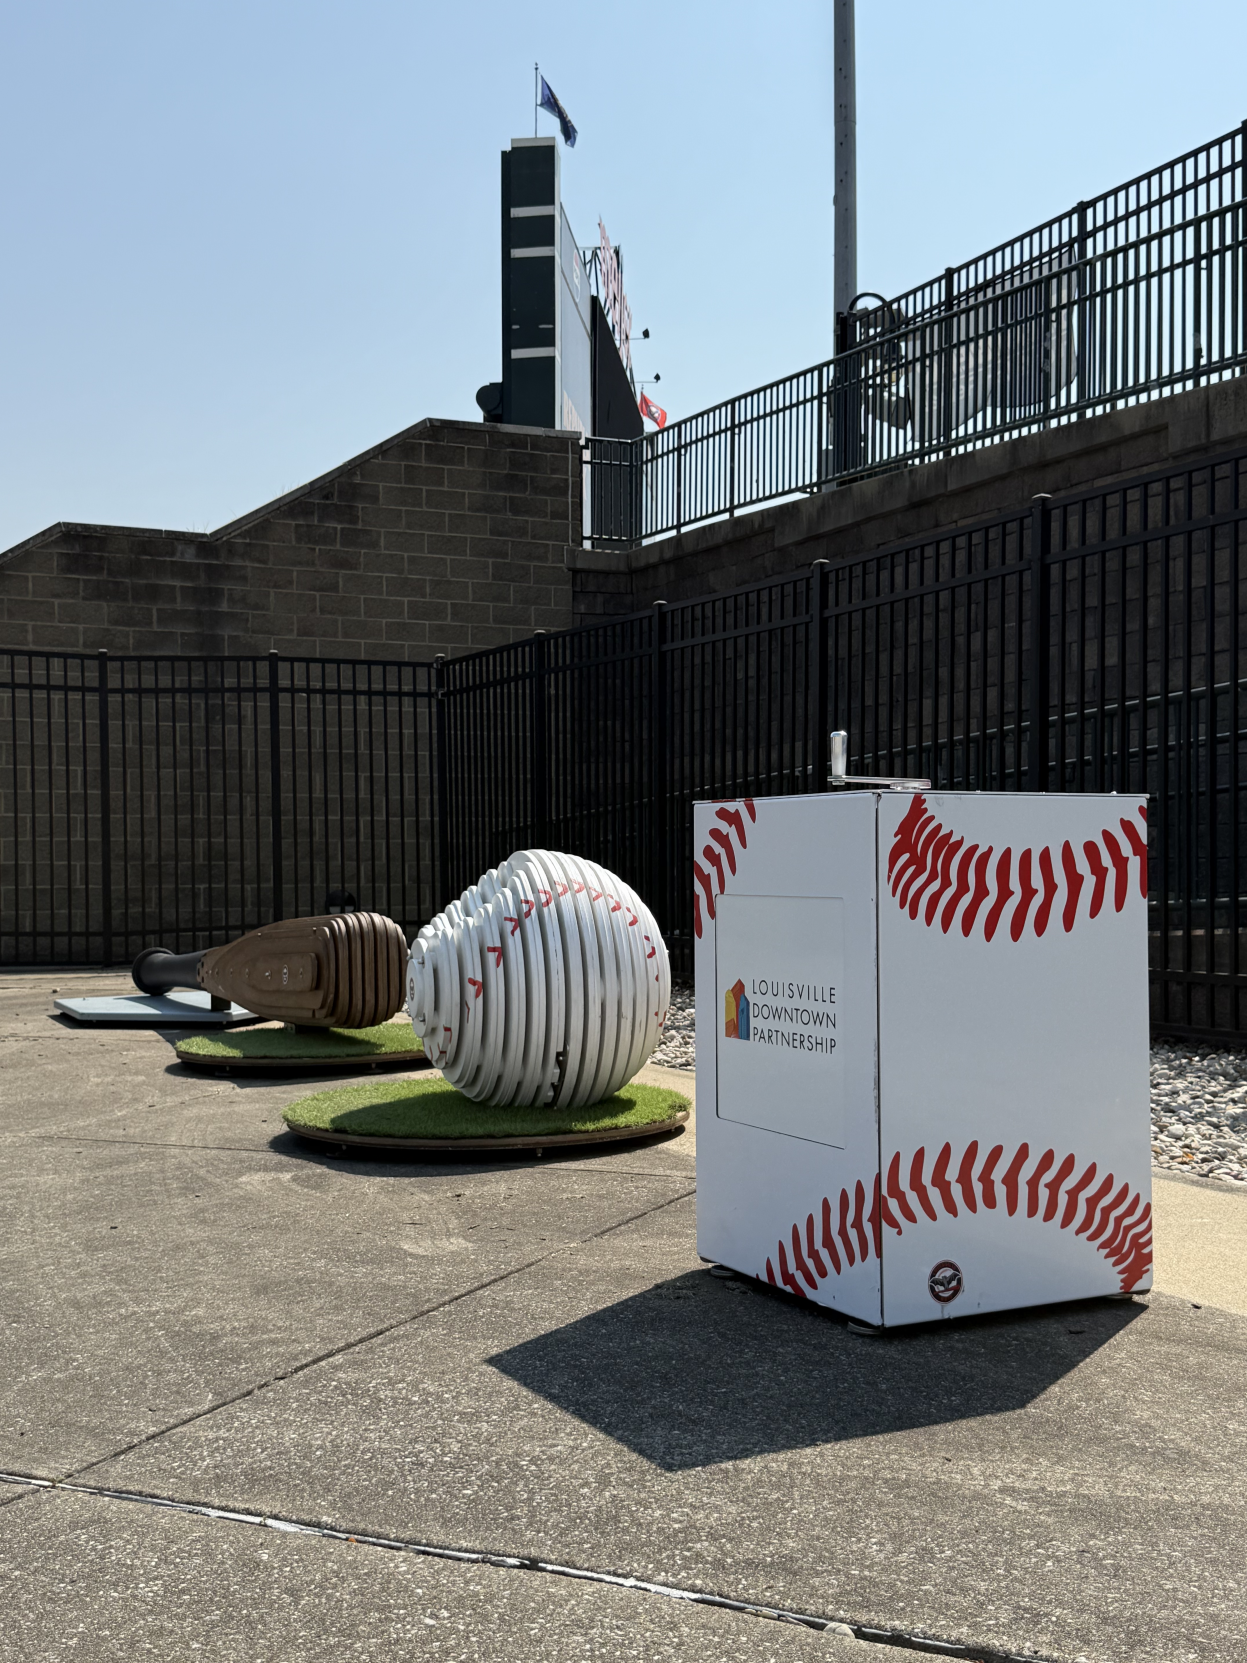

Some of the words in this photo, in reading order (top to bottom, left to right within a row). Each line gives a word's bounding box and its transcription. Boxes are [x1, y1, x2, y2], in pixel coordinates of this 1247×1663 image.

[752, 979, 836, 1004] LOUISVILLE
[752, 1002, 836, 1029] DOWNTOWN
[753, 1026, 837, 1054] PARTNERSHIP
